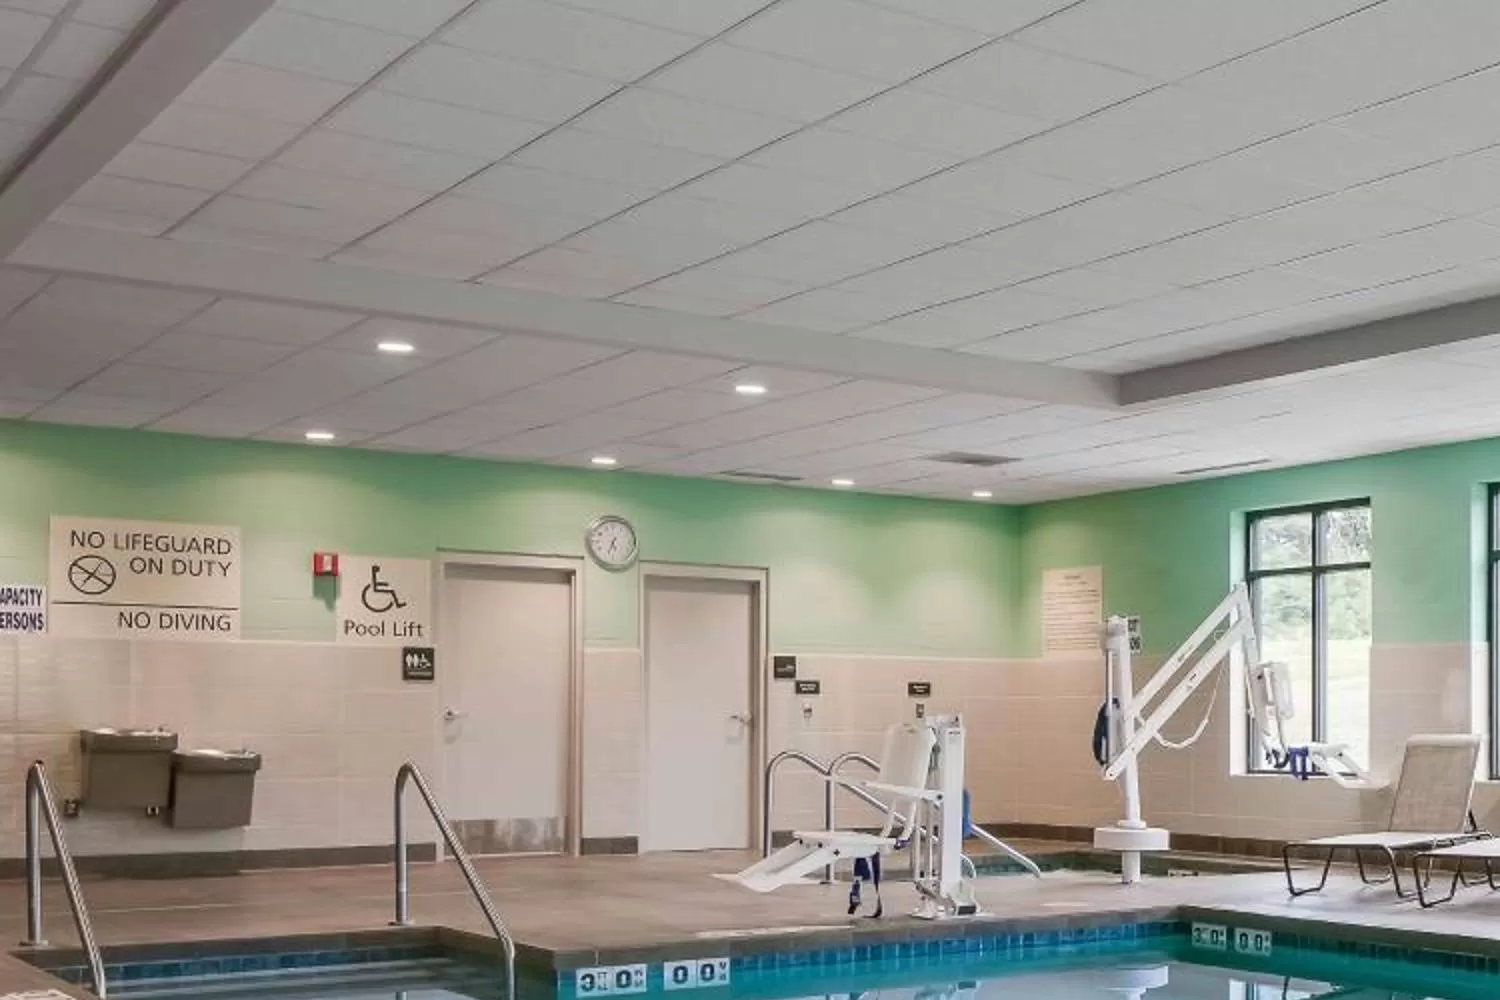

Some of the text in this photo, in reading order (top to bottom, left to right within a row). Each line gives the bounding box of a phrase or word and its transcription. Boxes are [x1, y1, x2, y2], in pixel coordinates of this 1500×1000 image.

[71, 530, 232, 554] NO LIFEGUARD
[129, 556, 233, 577] ON DUTY
[118, 611, 232, 631] NO DIVING
[344, 619, 425, 637] Pool Lift
